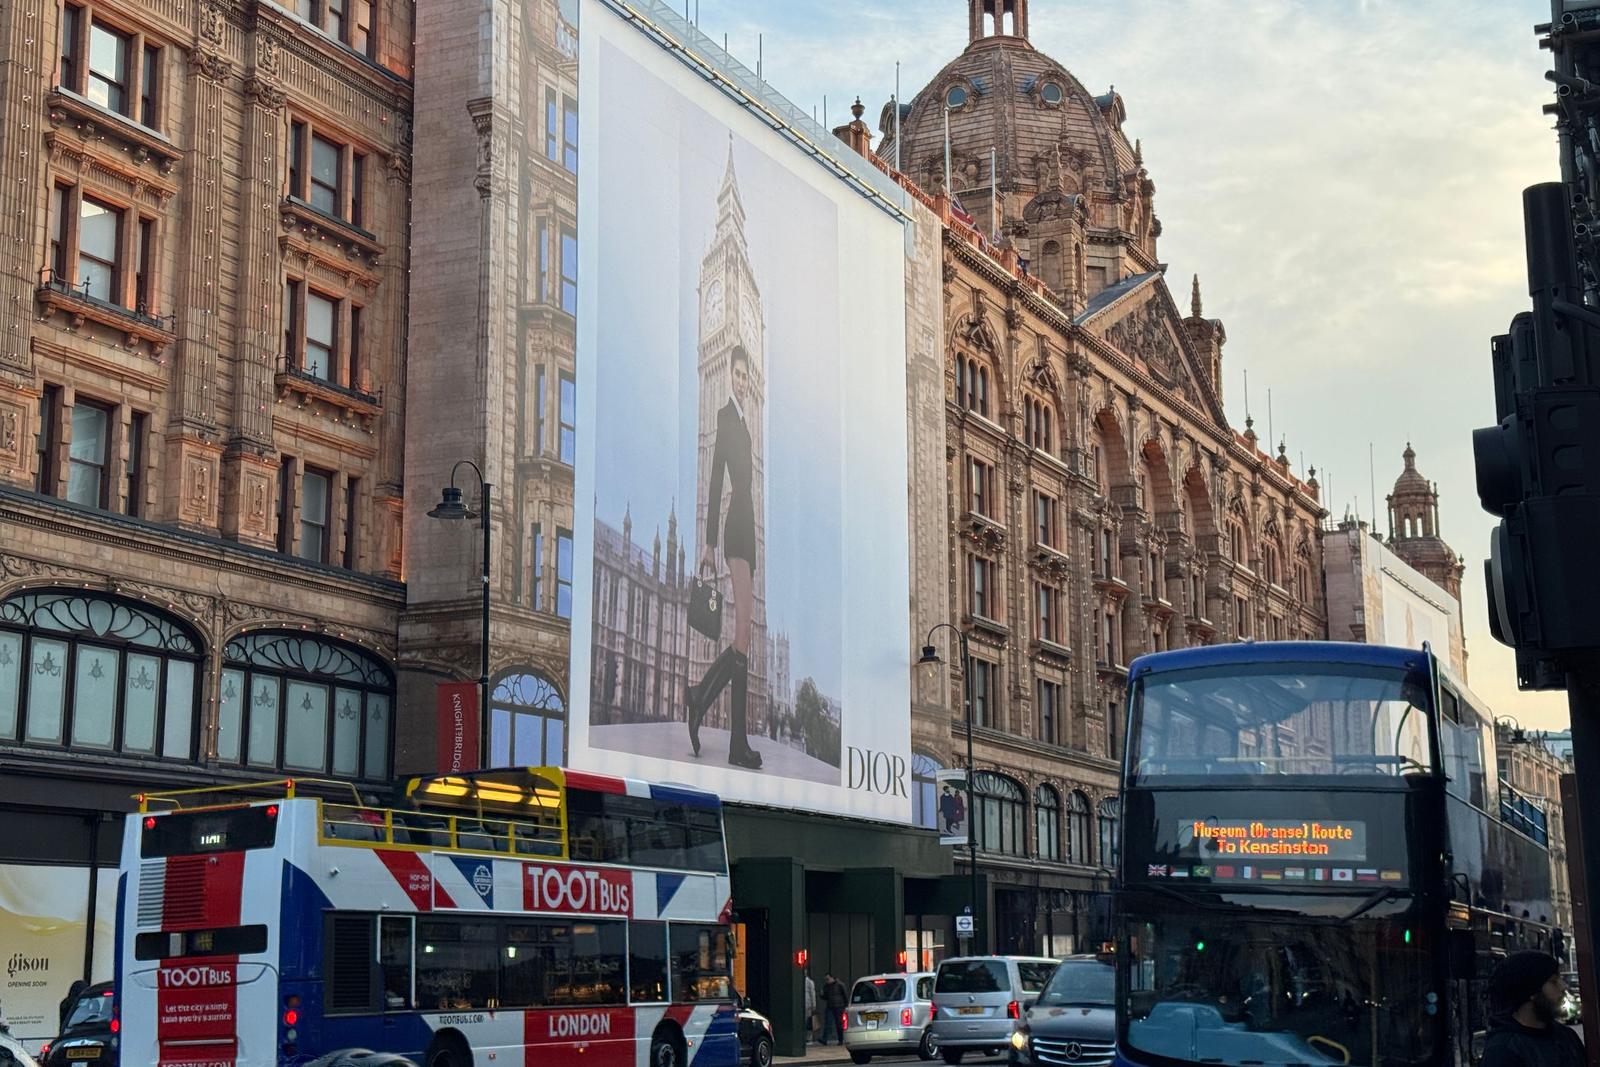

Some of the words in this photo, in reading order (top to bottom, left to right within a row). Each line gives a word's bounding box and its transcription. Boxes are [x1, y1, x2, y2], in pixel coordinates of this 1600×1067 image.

[847, 747, 908, 799] DIOR
[1193, 822, 1247, 838] Museum
[1250, 823, 1308, 838] (Orange)
[1311, 823, 1352, 839] Route
[1217, 840, 1236, 854] To
[549, 1013, 611, 1037] LONDON
